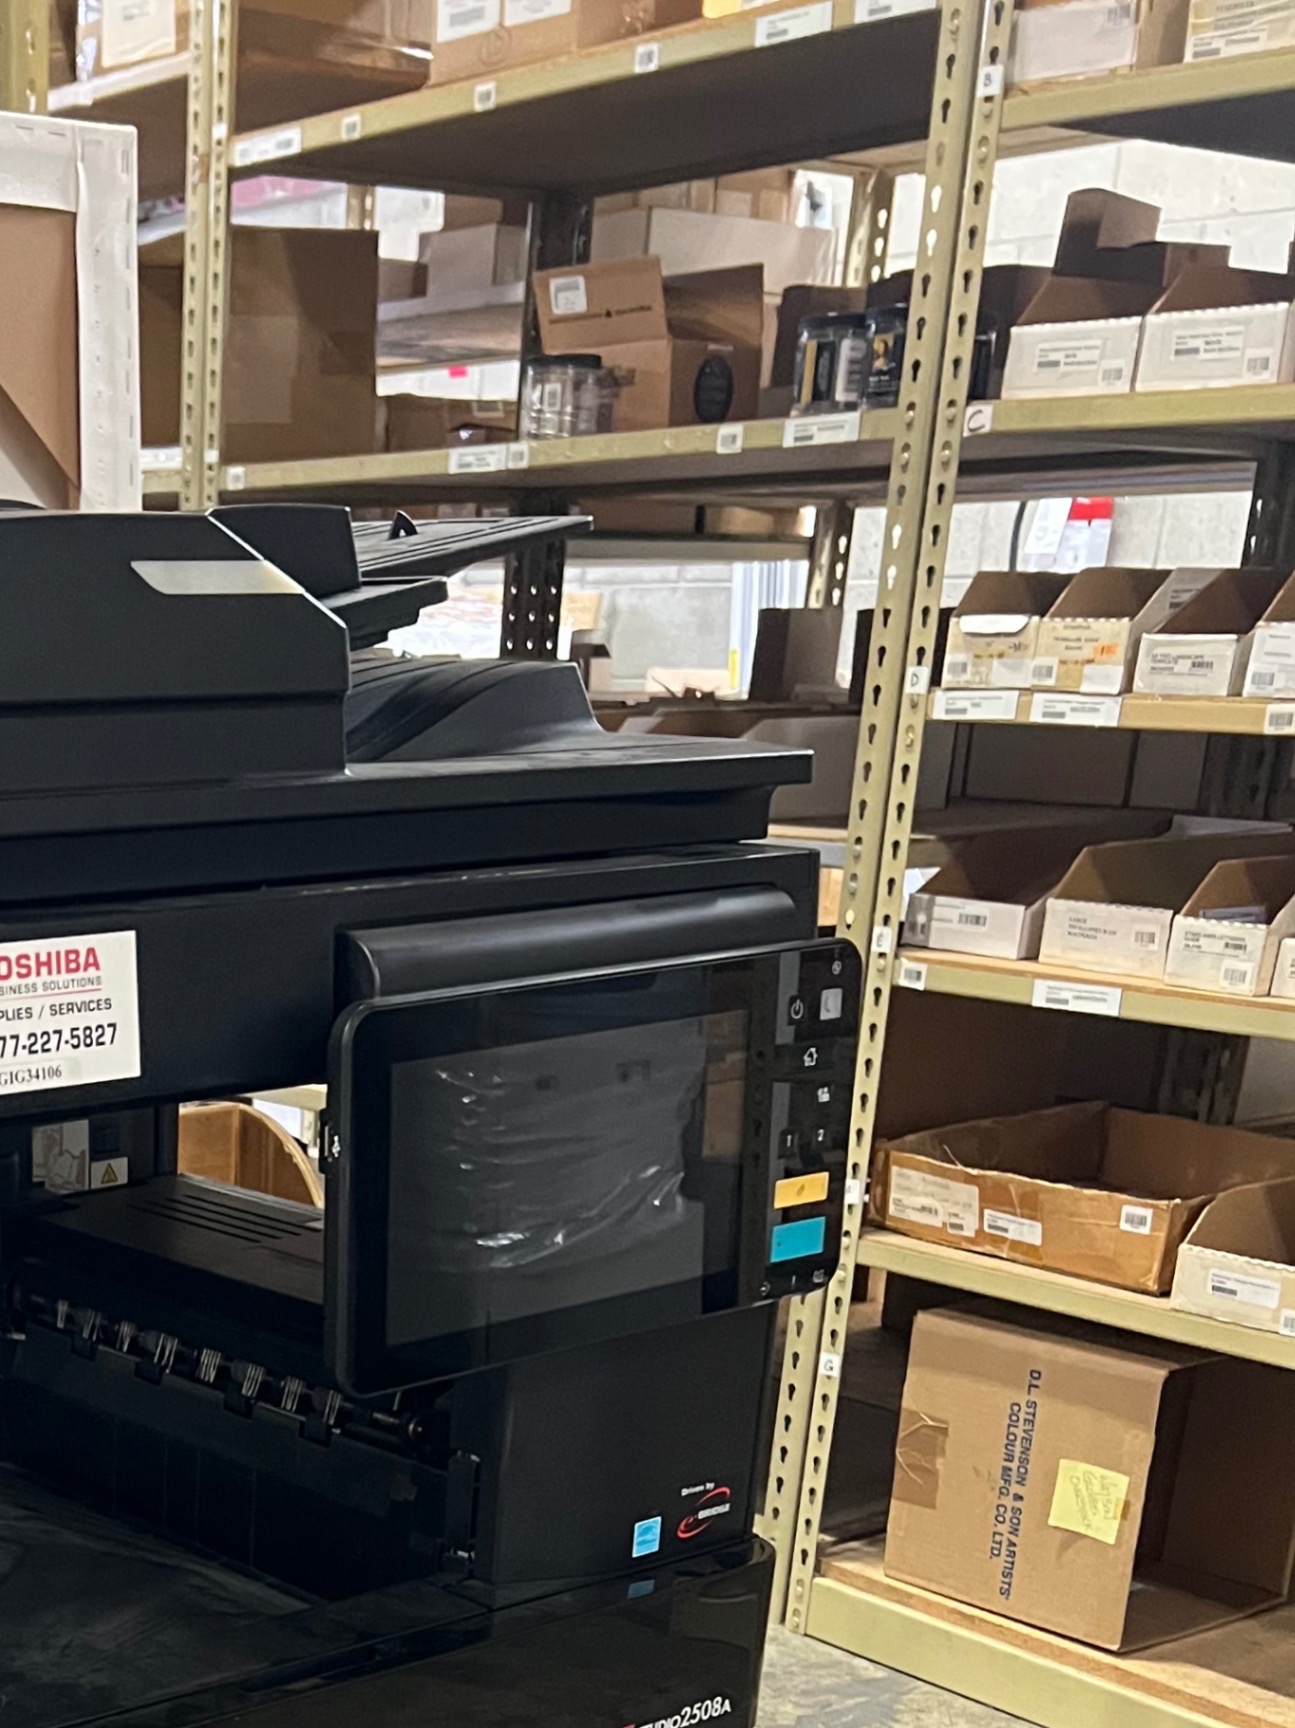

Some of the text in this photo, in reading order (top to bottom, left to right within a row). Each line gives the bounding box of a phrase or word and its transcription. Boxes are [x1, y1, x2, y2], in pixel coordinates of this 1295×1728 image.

[967, 409, 986, 432] C
[910, 672, 919, 687] D
[42, 976, 102, 992] SOLUTIONS
[38, 1004, 45, 1020] /
[49, 998, 112, 1017] SERVICES
[1004, 1402, 1021, 1464] COLOUR
[1017, 1399, 1037, 1487] STEVENSON
[1012, 1491, 1025, 1503] &
[1009, 1505, 1023, 1535] SON
[989, 1531, 1004, 1560] LTD.
